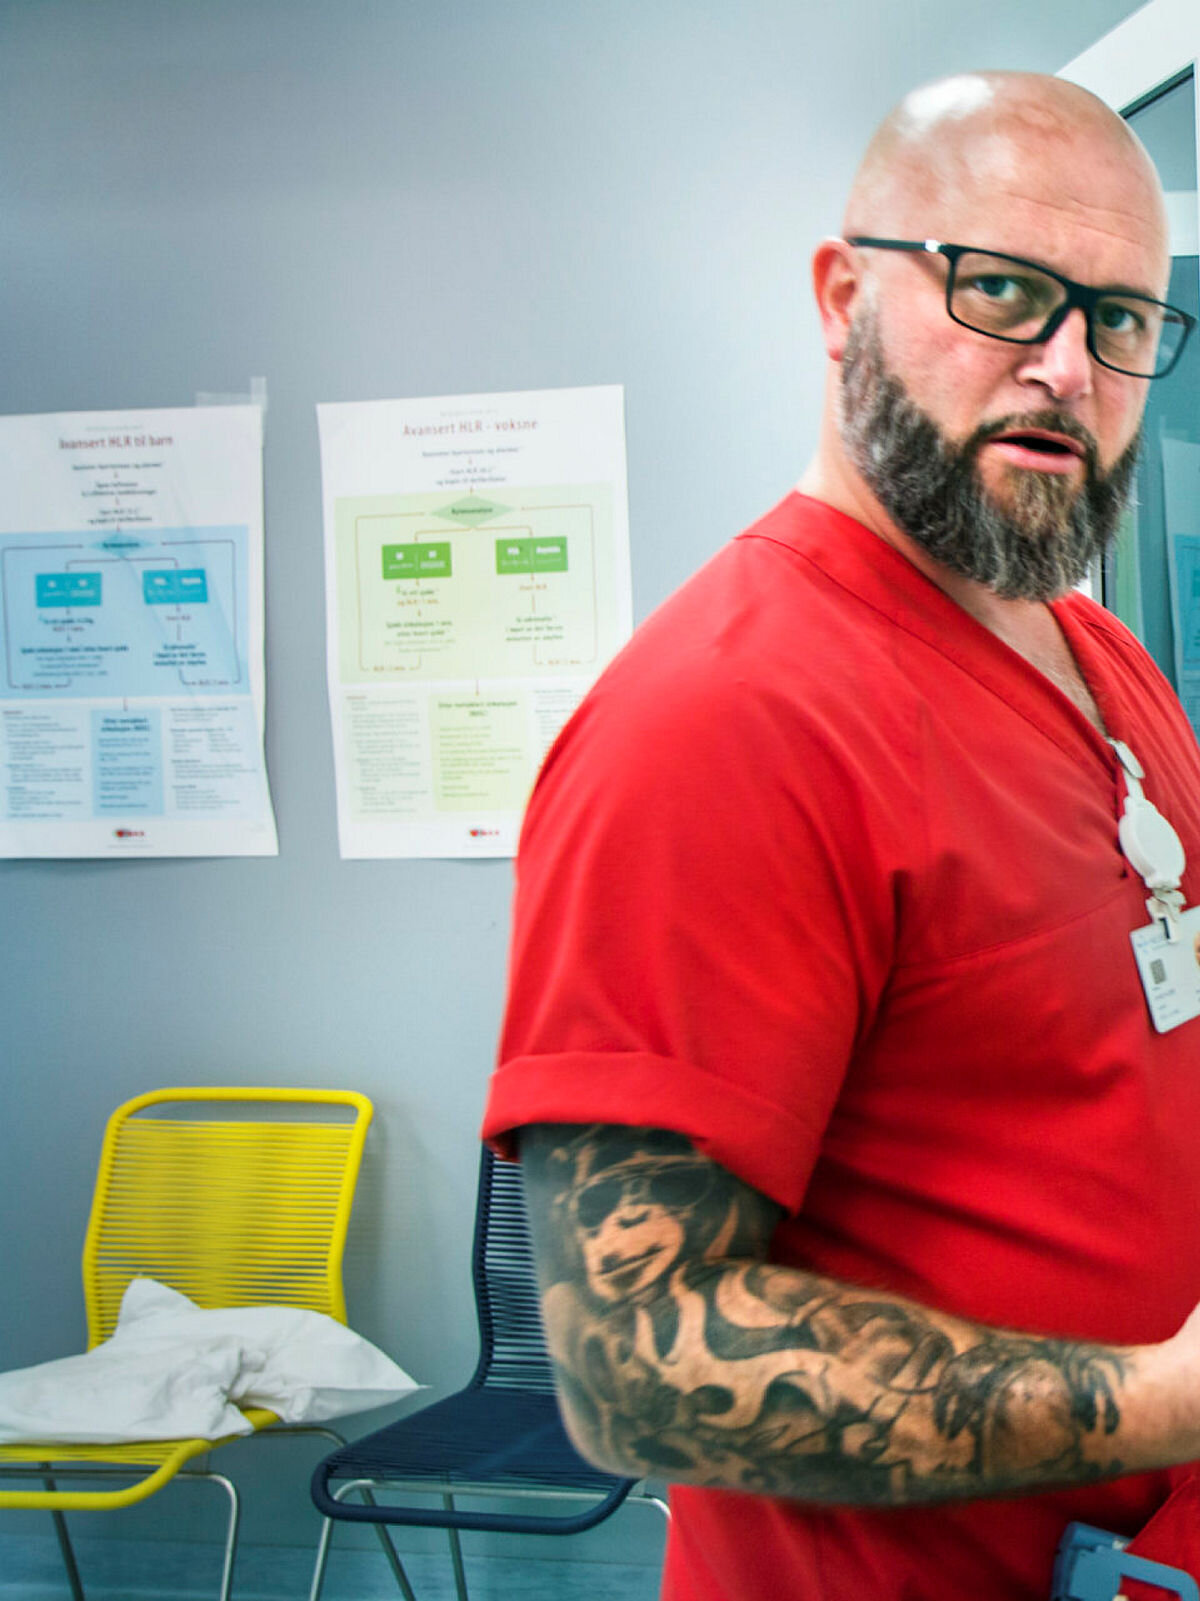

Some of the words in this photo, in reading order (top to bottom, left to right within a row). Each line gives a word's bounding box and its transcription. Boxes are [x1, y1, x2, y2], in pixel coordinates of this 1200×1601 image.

[403, 423, 455, 436] Avansert
[459, 419, 482, 433] HLR
[494, 418, 537, 431] voksne
[149, 434, 173, 446] barn
